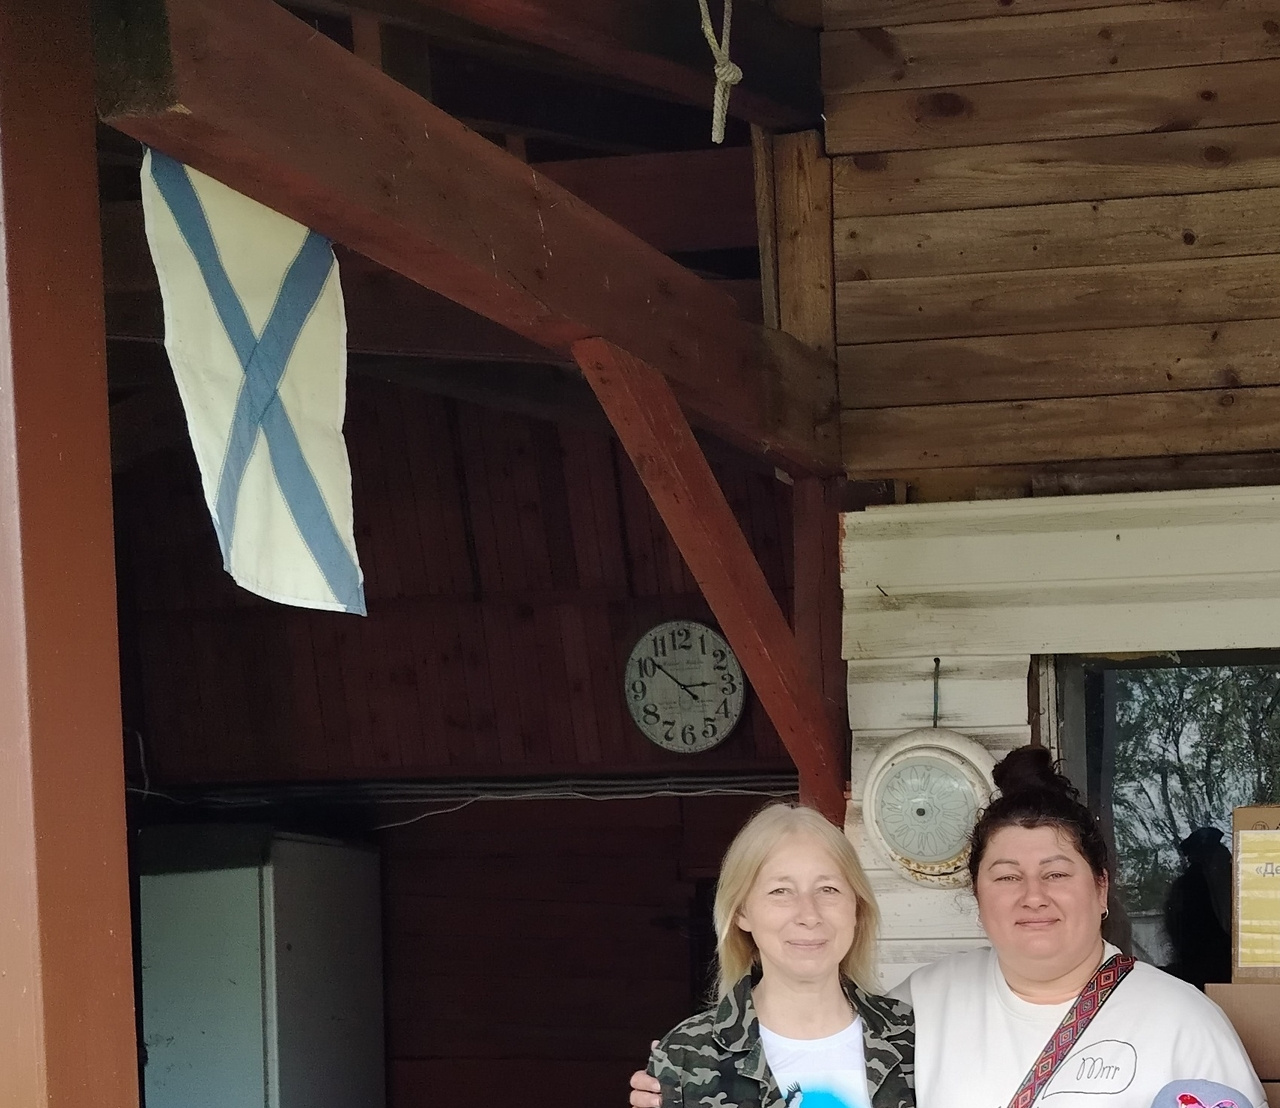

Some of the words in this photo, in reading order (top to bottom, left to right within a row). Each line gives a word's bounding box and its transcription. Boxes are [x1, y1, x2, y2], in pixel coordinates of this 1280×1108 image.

[652, 635, 667, 657] 11
[669, 628, 692, 650] 12
[699, 634, 706, 655] 1
[636, 657, 657, 678] 10
[712, 649, 728, 671] 2
[631, 680, 647, 701] 9
[721, 673, 737, 695] 3
[642, 703, 660, 726] 8
[715, 698, 731, 719] 4
[662, 719, 676, 742] 7
[681, 724, 696, 746] 6
[702, 717, 718, 738] 5
[1076, 1056, 1120, 1081] Mrrr
